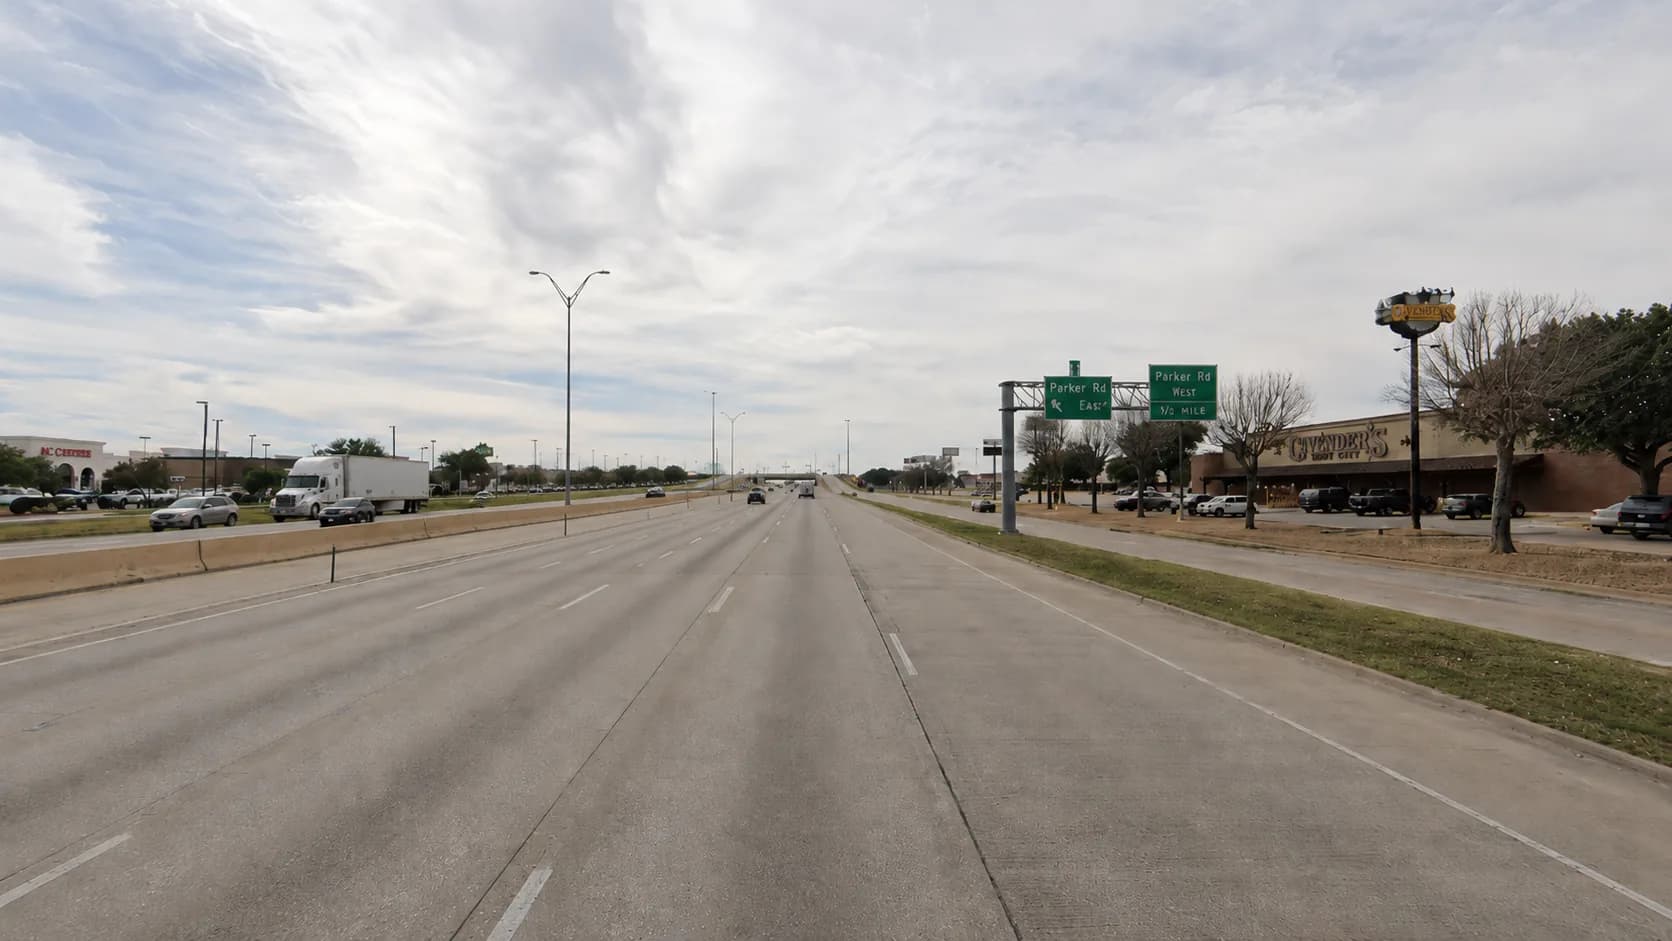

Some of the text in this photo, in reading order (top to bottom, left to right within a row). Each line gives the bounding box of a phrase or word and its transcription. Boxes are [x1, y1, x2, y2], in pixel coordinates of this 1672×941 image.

[1155, 371, 1211, 381] Parker Rd
[1050, 382, 1106, 393] Parker Rd
[1181, 406, 1206, 415] MILE
